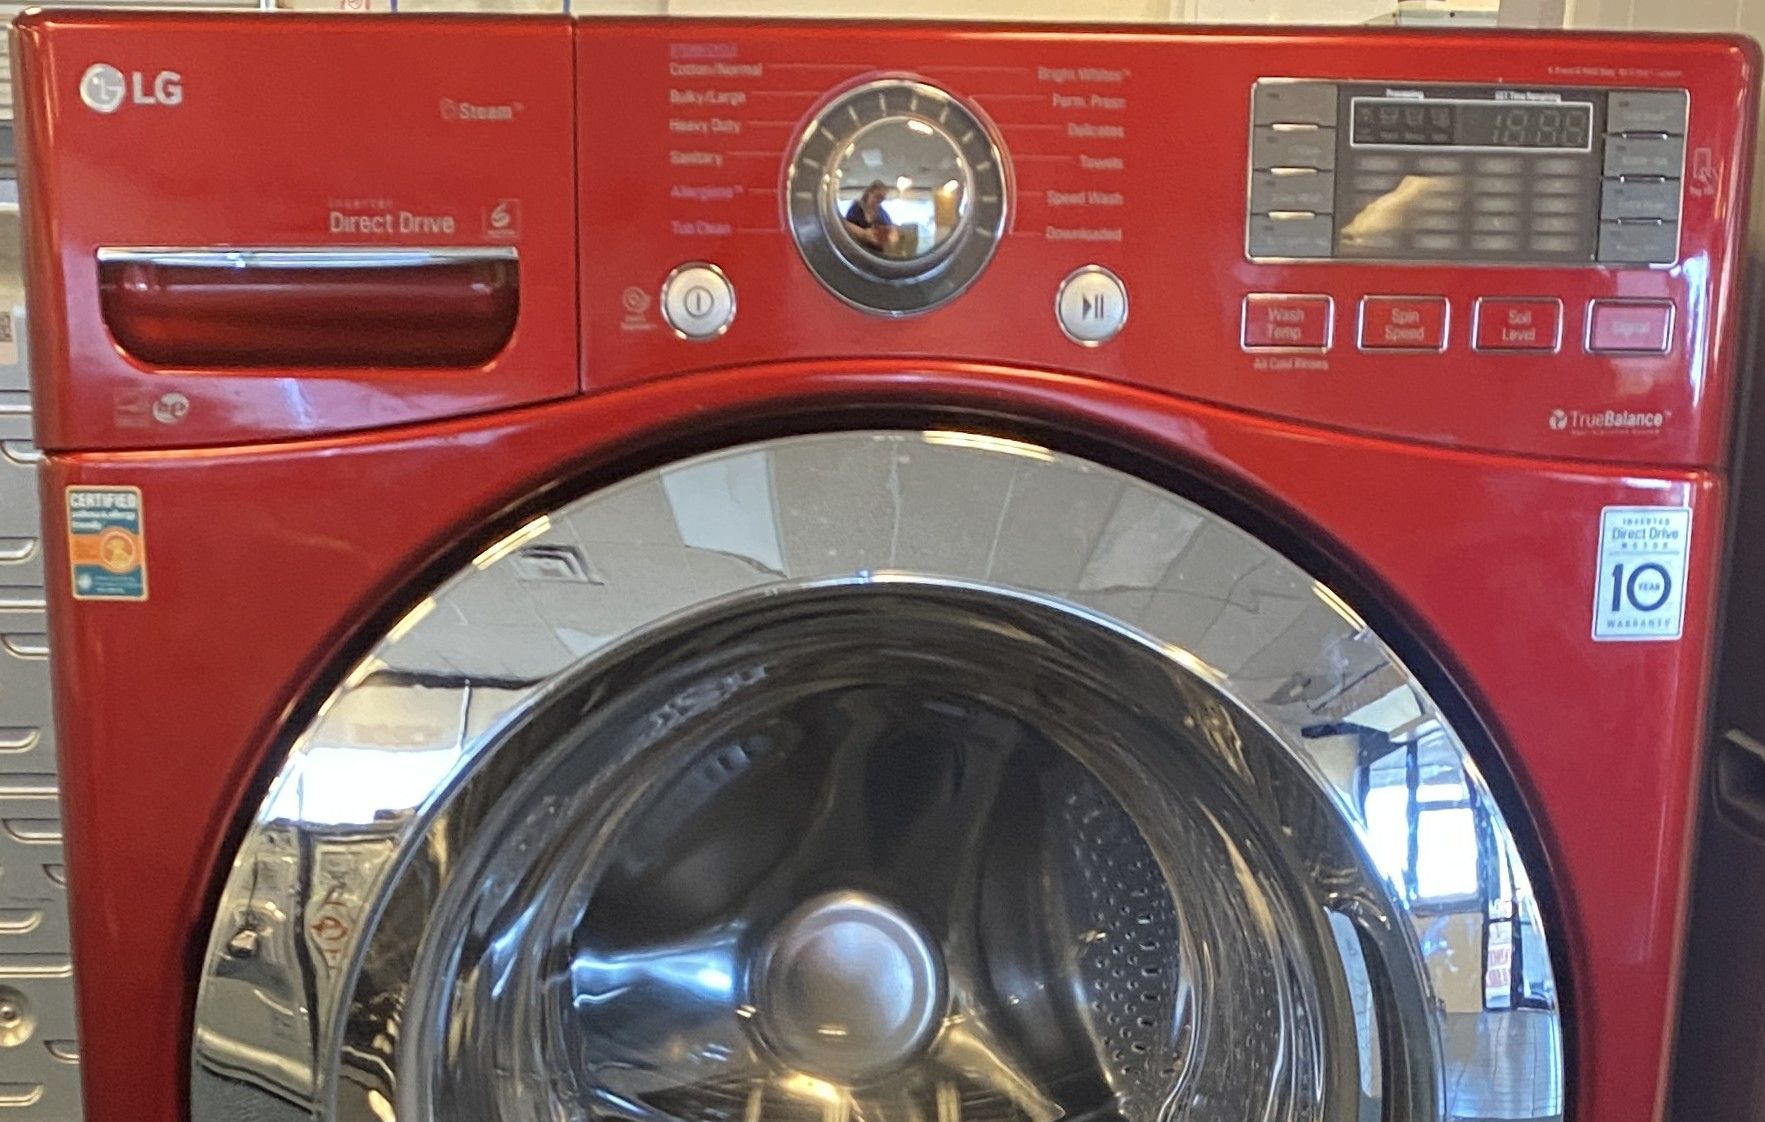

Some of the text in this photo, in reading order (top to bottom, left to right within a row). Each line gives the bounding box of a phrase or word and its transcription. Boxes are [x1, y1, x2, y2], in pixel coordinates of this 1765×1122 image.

[132, 71, 183, 105] LG
[330, 211, 455, 233] Direct Drive
[1268, 308, 1304, 323] Wash
[1391, 308, 1420, 324] Spin
[1508, 310, 1532, 324] Soil
[1267, 324, 1301, 340] Temp
[1385, 325, 1424, 341] Speed
[1502, 328, 1536, 341] Level
[1612, 526, 1679, 540] Direct Drive
[1611, 562, 1672, 612] 10
[1638, 583, 1661, 591] YEAR
[1606, 618, 1673, 629] WARRANTY
